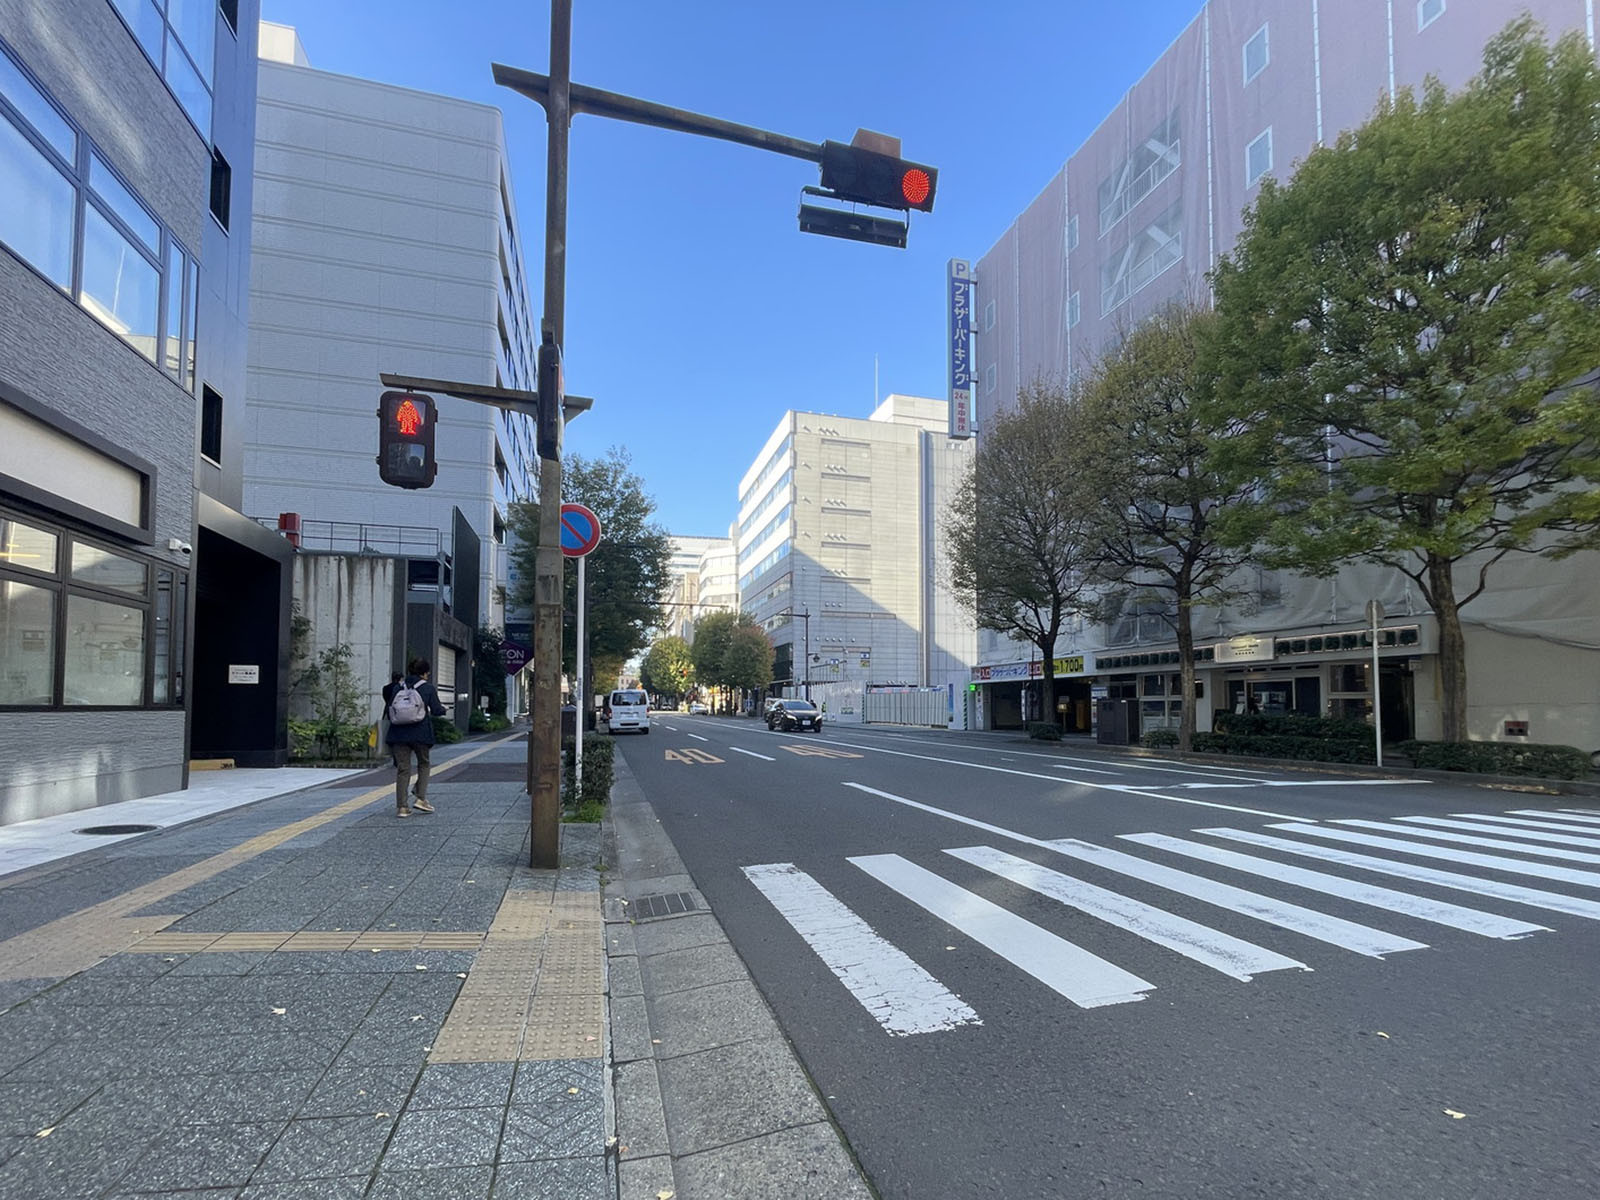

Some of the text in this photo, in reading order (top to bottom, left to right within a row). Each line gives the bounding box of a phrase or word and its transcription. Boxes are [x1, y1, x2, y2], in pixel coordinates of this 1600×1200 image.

[956, 262, 967, 276] P
[953, 282, 969, 385] ブラザーパーキング
[665, 749, 726, 765] 40
